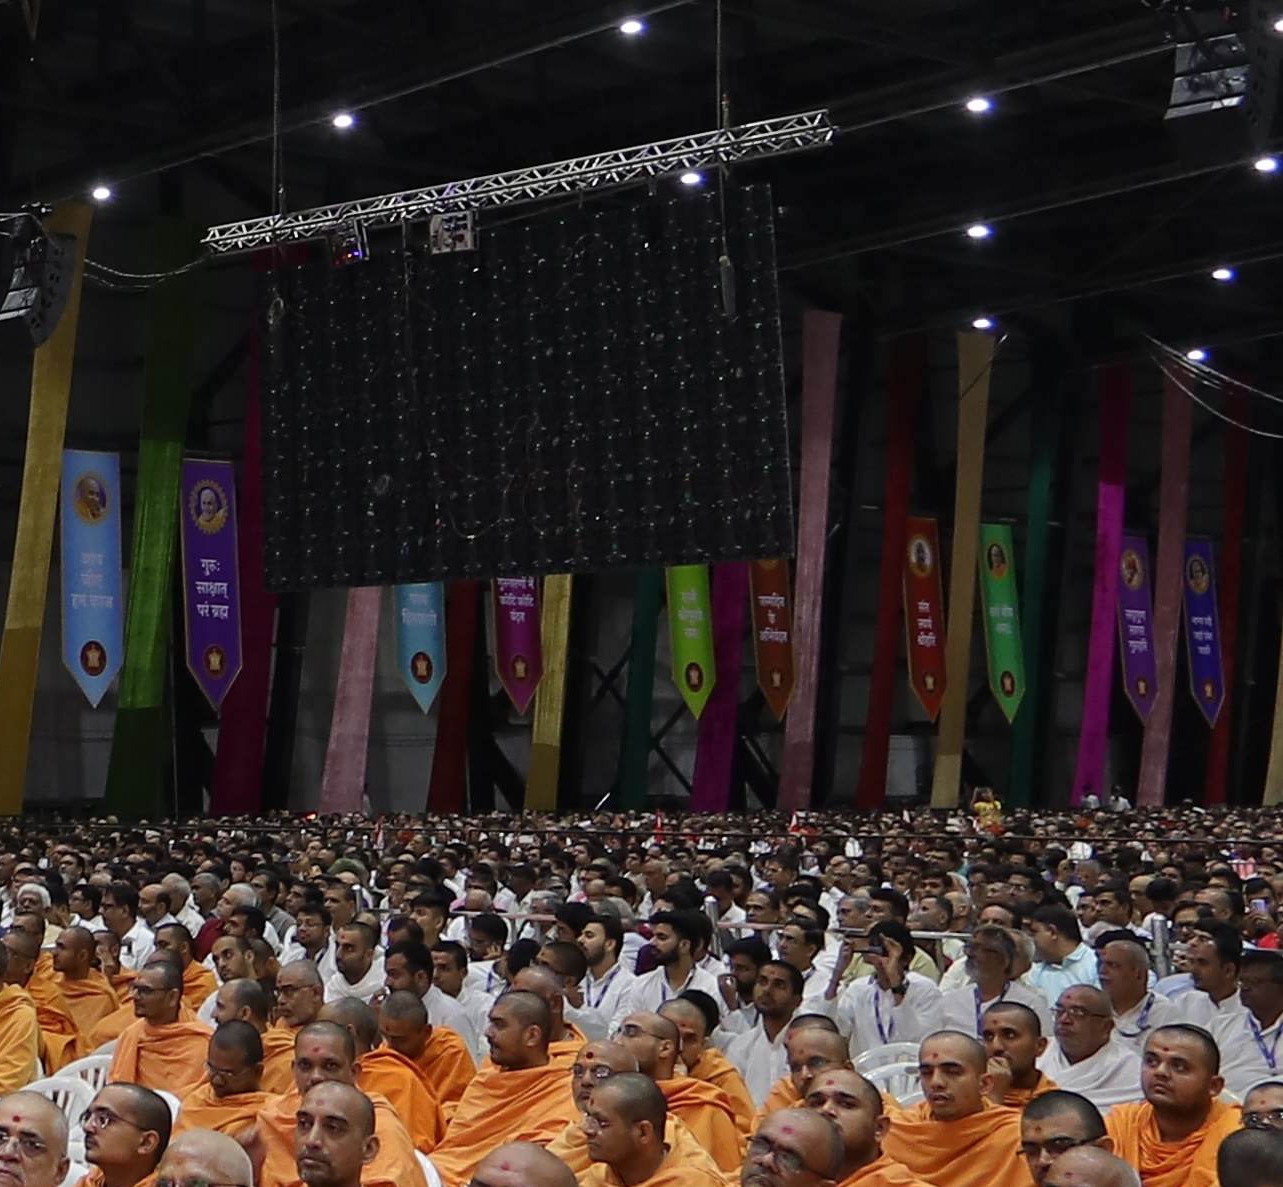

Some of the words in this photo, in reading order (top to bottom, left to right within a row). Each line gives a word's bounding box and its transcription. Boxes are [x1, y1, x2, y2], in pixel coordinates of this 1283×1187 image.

[200, 558, 221, 576] गुरुः
[195, 580, 229, 599] साक्षात्
[196, 602, 210, 618] परं
[211, 604, 229, 620] ब्रह्म
